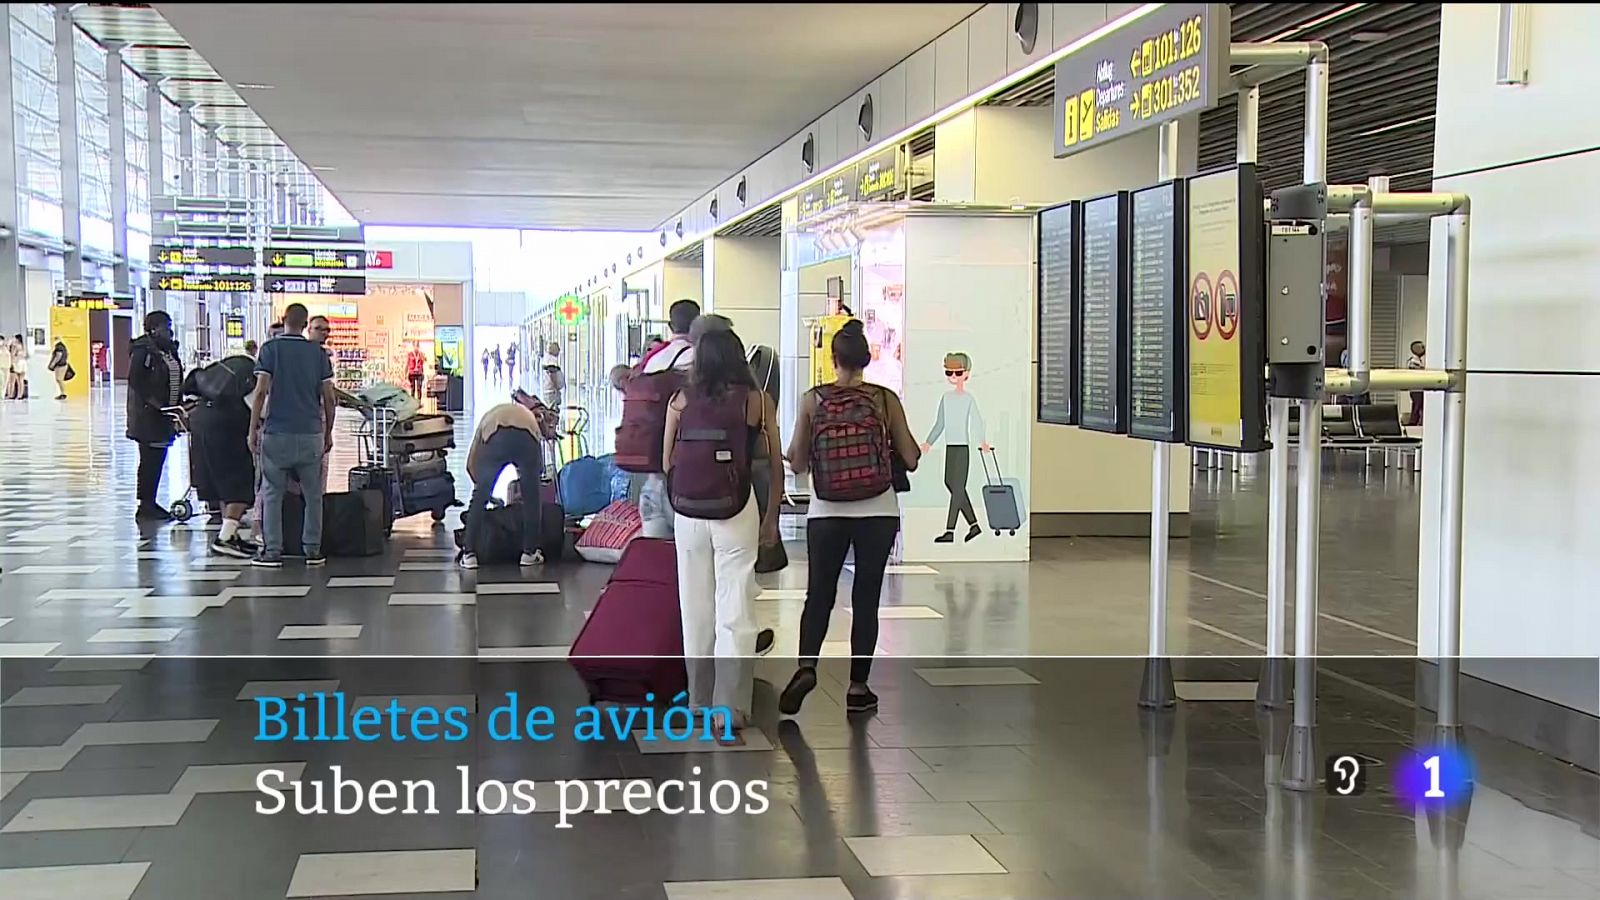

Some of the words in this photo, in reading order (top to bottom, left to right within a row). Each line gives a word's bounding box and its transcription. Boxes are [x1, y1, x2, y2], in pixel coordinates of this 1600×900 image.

[1153, 30, 1174, 71] 101
[1180, 15, 1202, 60] 126
[1153, 75, 1173, 115] 301
[1178, 65, 1200, 105] 352
[1096, 107, 1120, 134] Salidas
[213, 280, 229, 291] 101
[235, 280, 251, 291] 126
